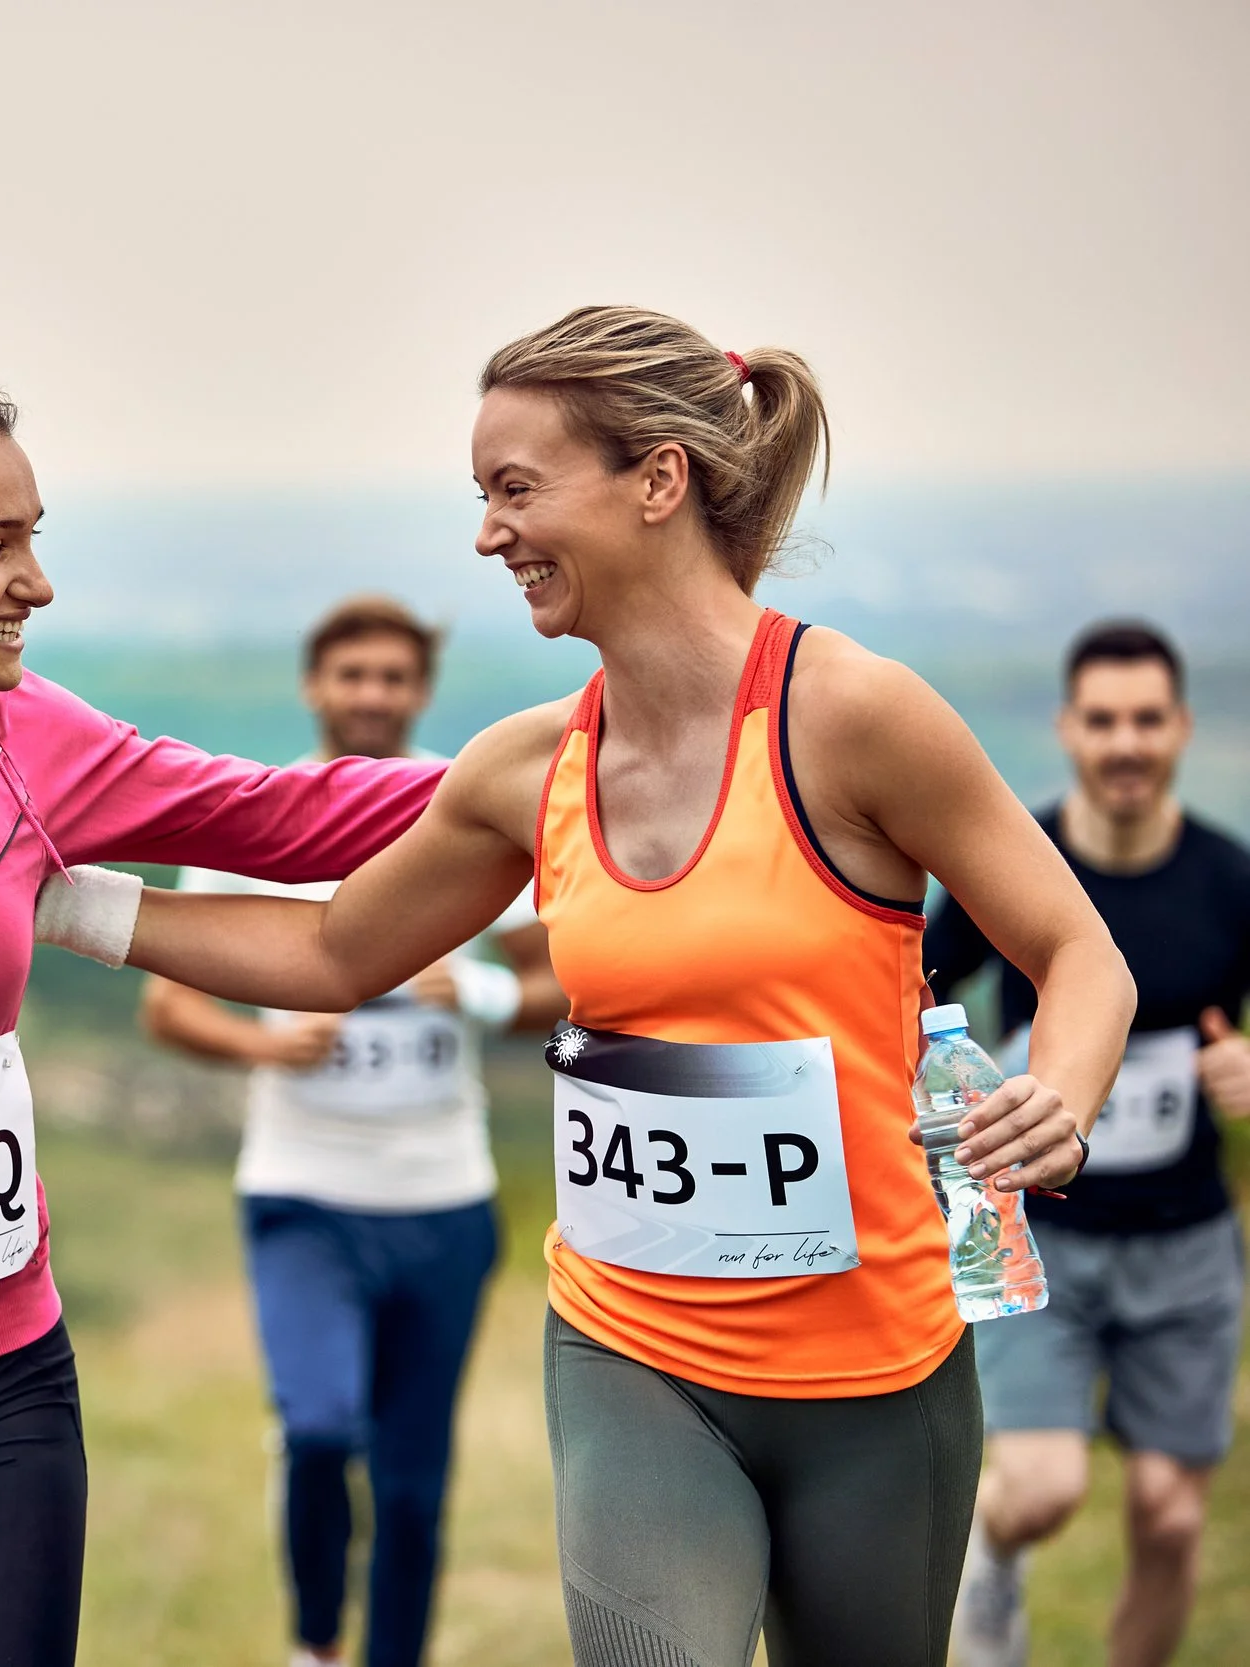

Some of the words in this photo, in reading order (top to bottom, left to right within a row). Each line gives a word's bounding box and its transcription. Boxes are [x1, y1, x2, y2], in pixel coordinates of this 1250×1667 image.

[567, 1109, 819, 1206] 343-P
[718, 1252, 746, 1265] run
[752, 1243, 785, 1270] for
[792, 1236, 833, 1267] life
